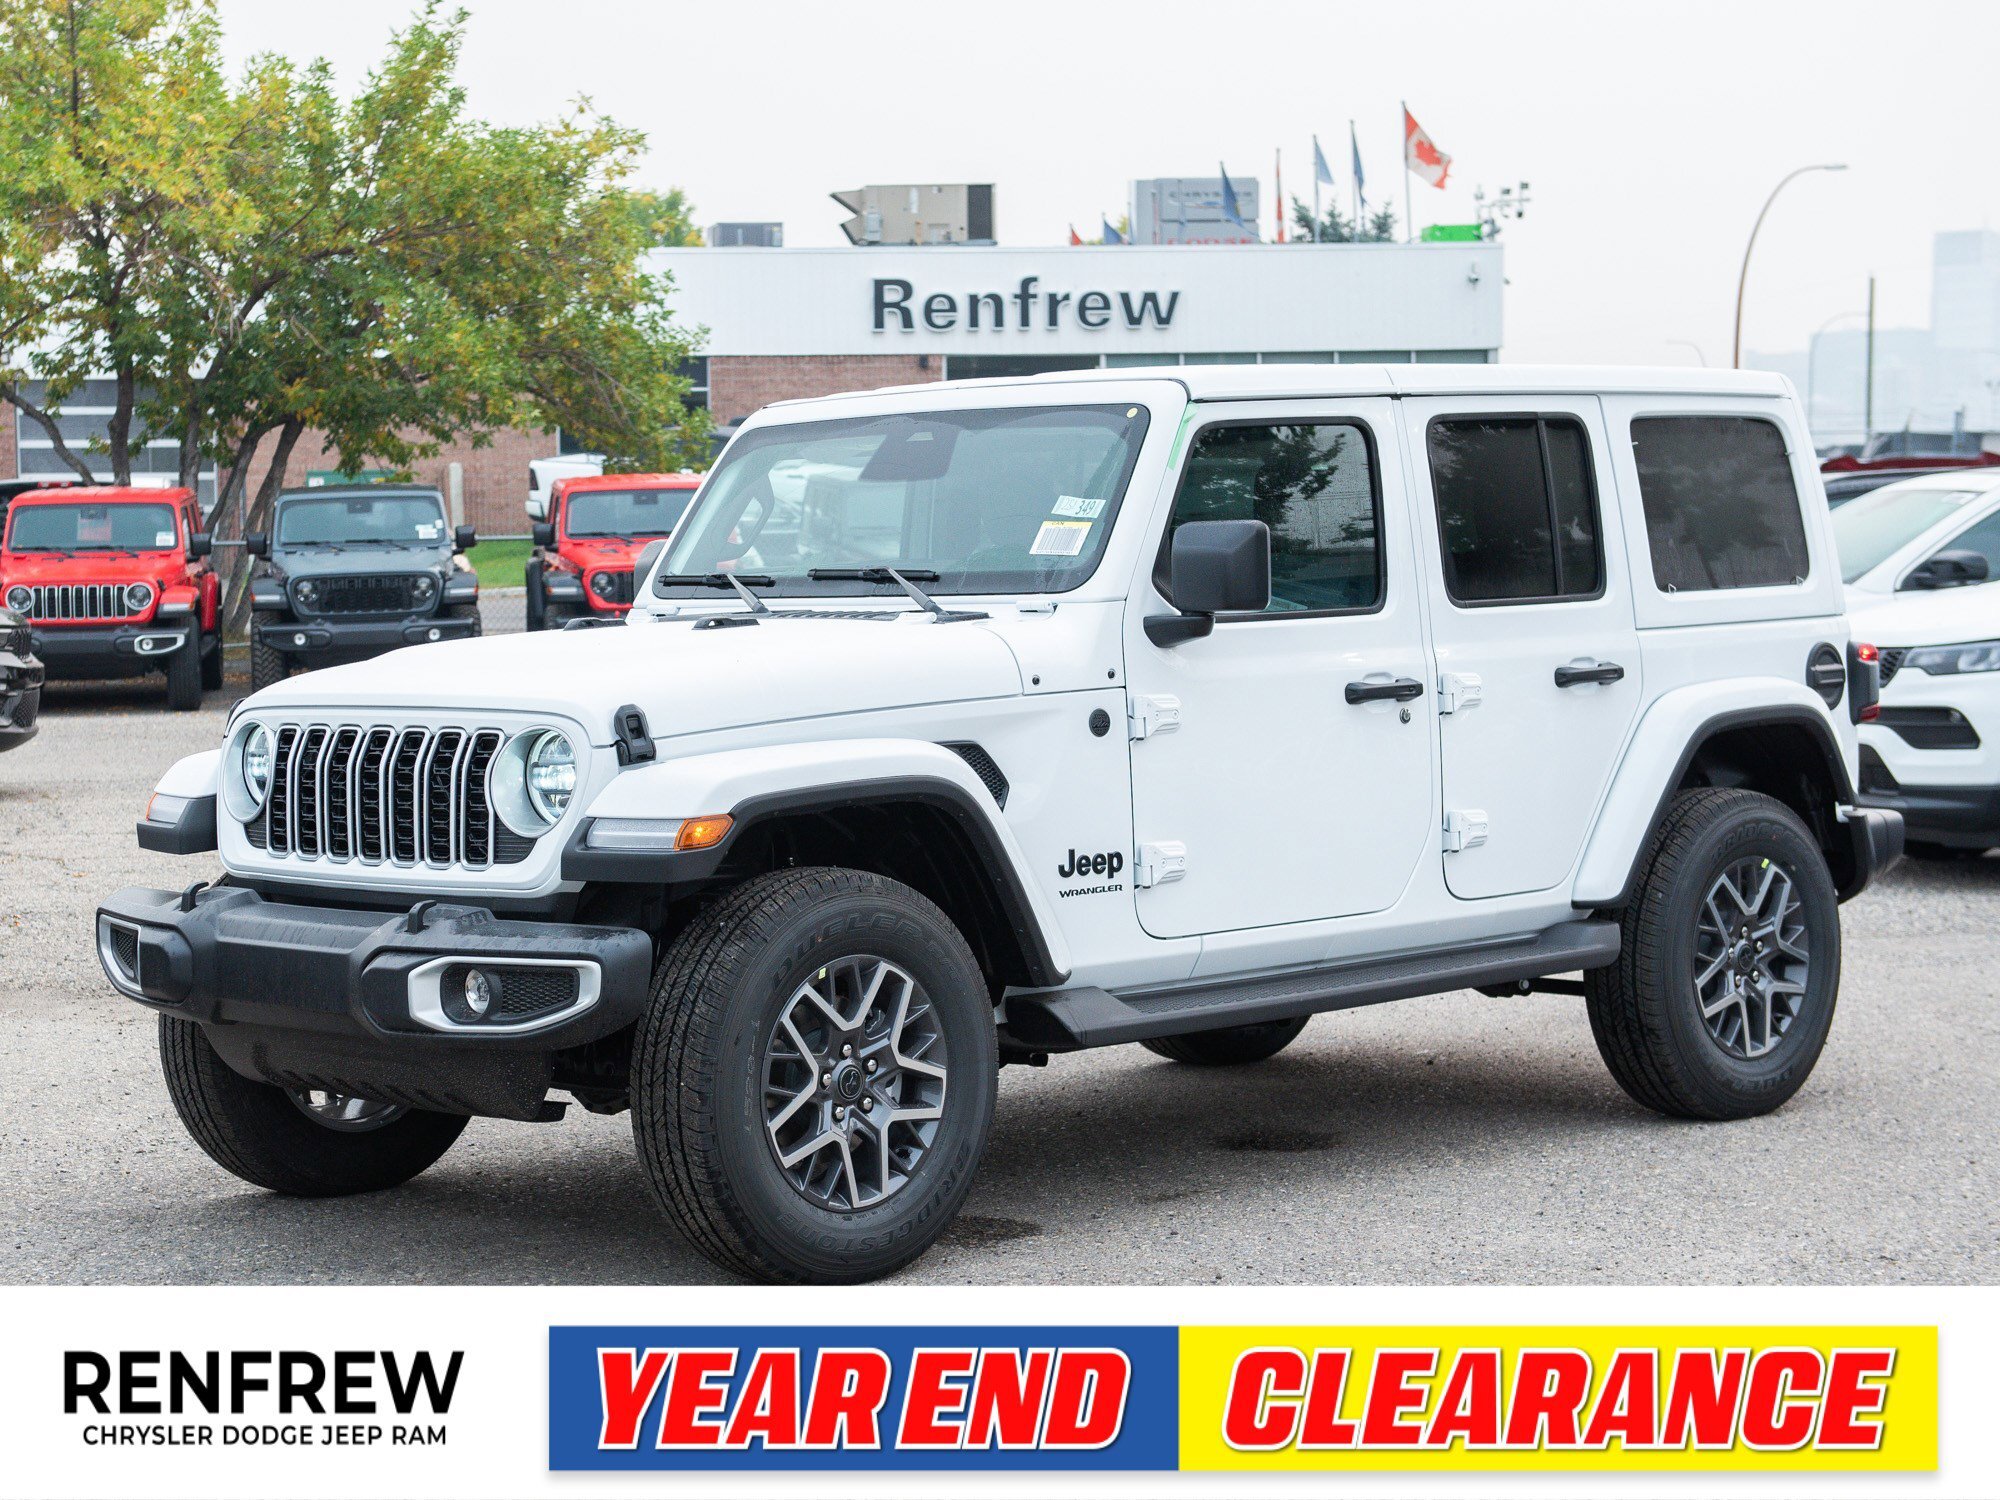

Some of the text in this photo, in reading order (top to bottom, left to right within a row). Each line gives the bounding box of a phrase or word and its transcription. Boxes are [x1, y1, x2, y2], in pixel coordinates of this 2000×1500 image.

[873, 276, 1180, 331] Renfrew
[1058, 848, 1123, 879] Jeep
[1059, 884, 1123, 898] WRANGLER
[775, 1136, 972, 1255] BRIDGESTONE
